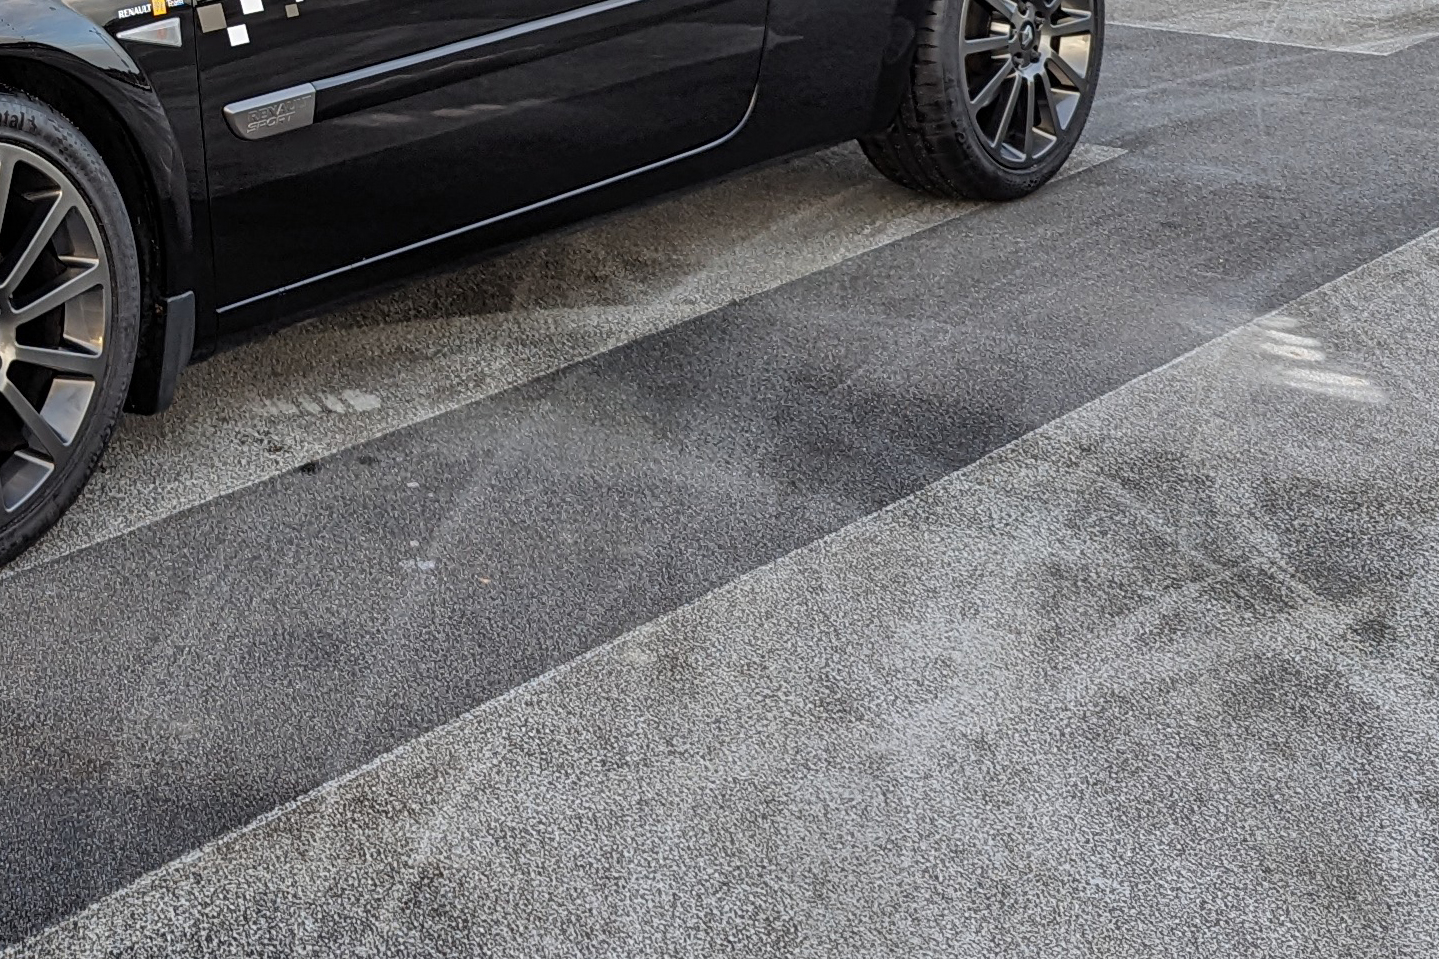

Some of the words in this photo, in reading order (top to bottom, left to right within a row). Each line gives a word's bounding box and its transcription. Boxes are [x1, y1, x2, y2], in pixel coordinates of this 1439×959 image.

[118, 3, 152, 19] RENAULT
[247, 95, 312, 122] RENAULT
[246, 111, 297, 133] SPORT
